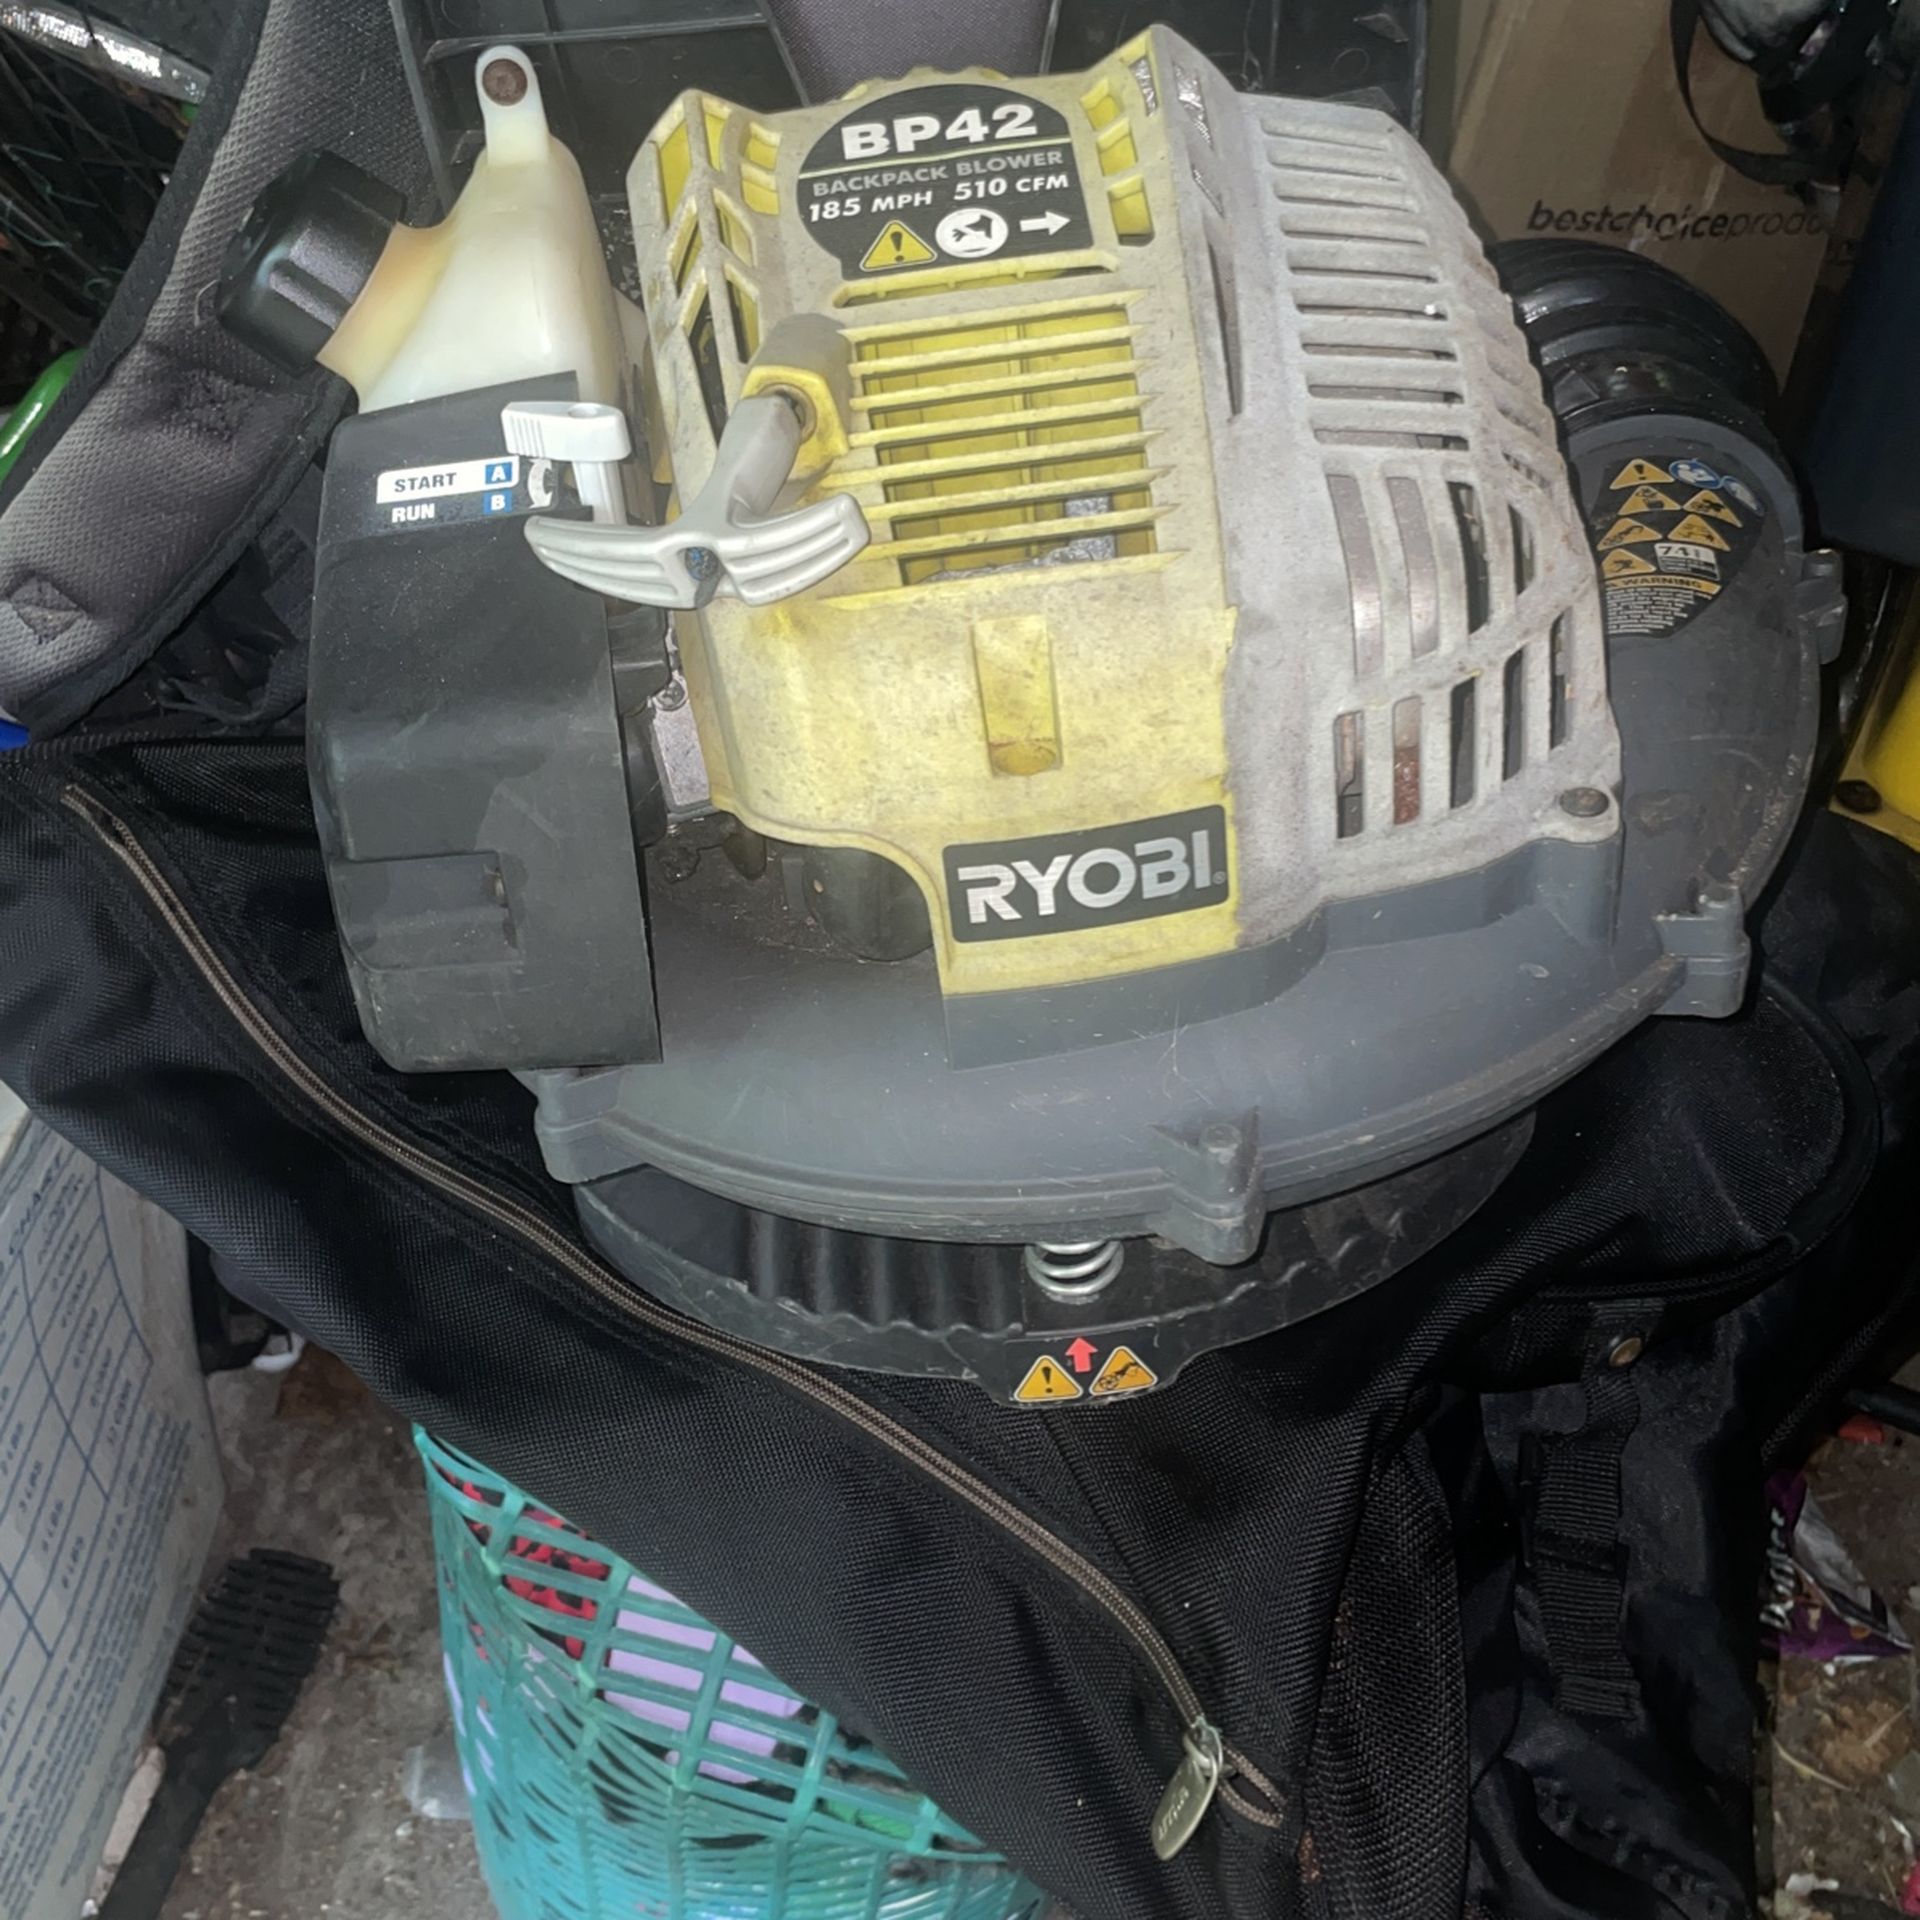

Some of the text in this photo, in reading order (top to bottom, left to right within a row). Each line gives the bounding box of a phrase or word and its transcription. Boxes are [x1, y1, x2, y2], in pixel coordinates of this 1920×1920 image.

[841, 104, 1037, 160] BP42
[813, 151, 1063, 197] BACKPACK BLOWER
[808, 174, 1069, 222] 185 MPH 510 CFM
[394, 466, 506, 493] START A
[392, 494, 506, 523] RUN B
[1622, 576, 1702, 589] WARNING
[957, 830, 1212, 924] RYOBI
